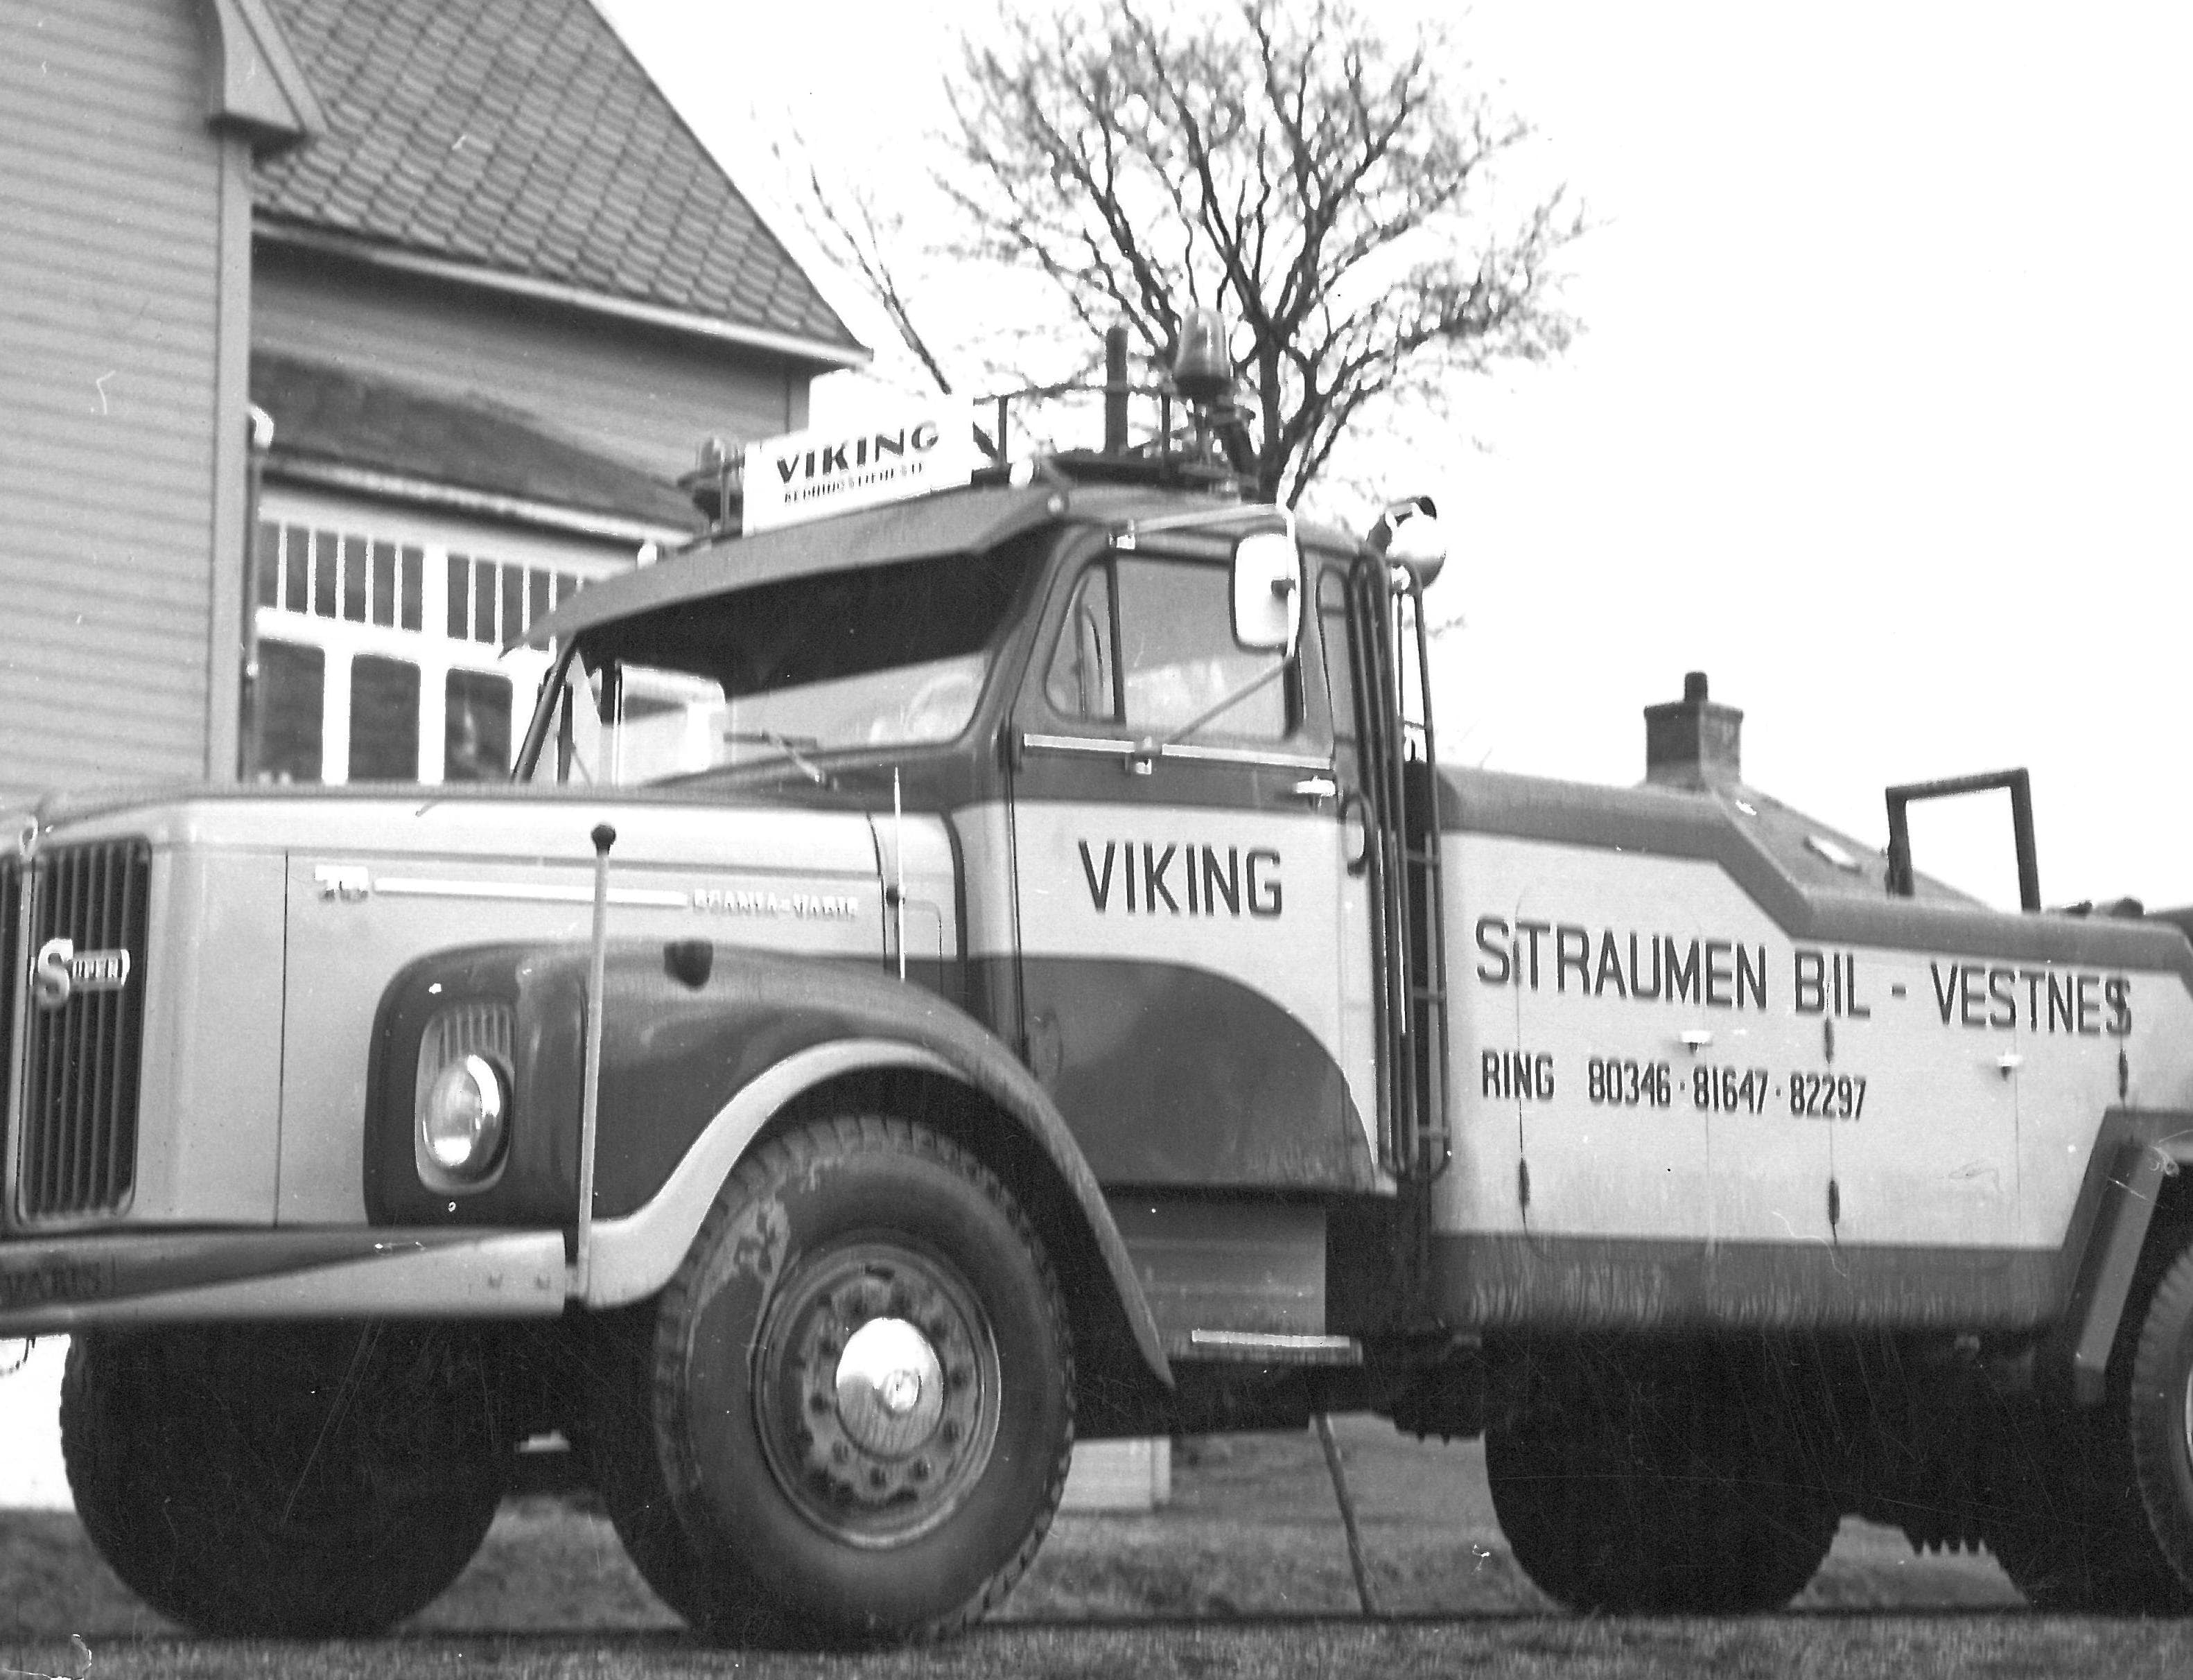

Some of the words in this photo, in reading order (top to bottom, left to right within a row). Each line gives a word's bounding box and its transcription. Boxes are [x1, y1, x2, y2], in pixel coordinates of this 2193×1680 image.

[776, 420, 938, 484] VIKING
[1078, 837, 1282, 918] VIKING
[1476, 915, 1767, 1010] STRAUMEN
[1794, 949, 1871, 1019] BIL
[1930, 961, 2132, 1038] VESTNES
[1482, 1049, 1554, 1102] RING
[1589, 1056, 1671, 1108] 80346
[1693, 1065, 1768, 1114] 81647
[1790, 1071, 1866, 1121] 82297
